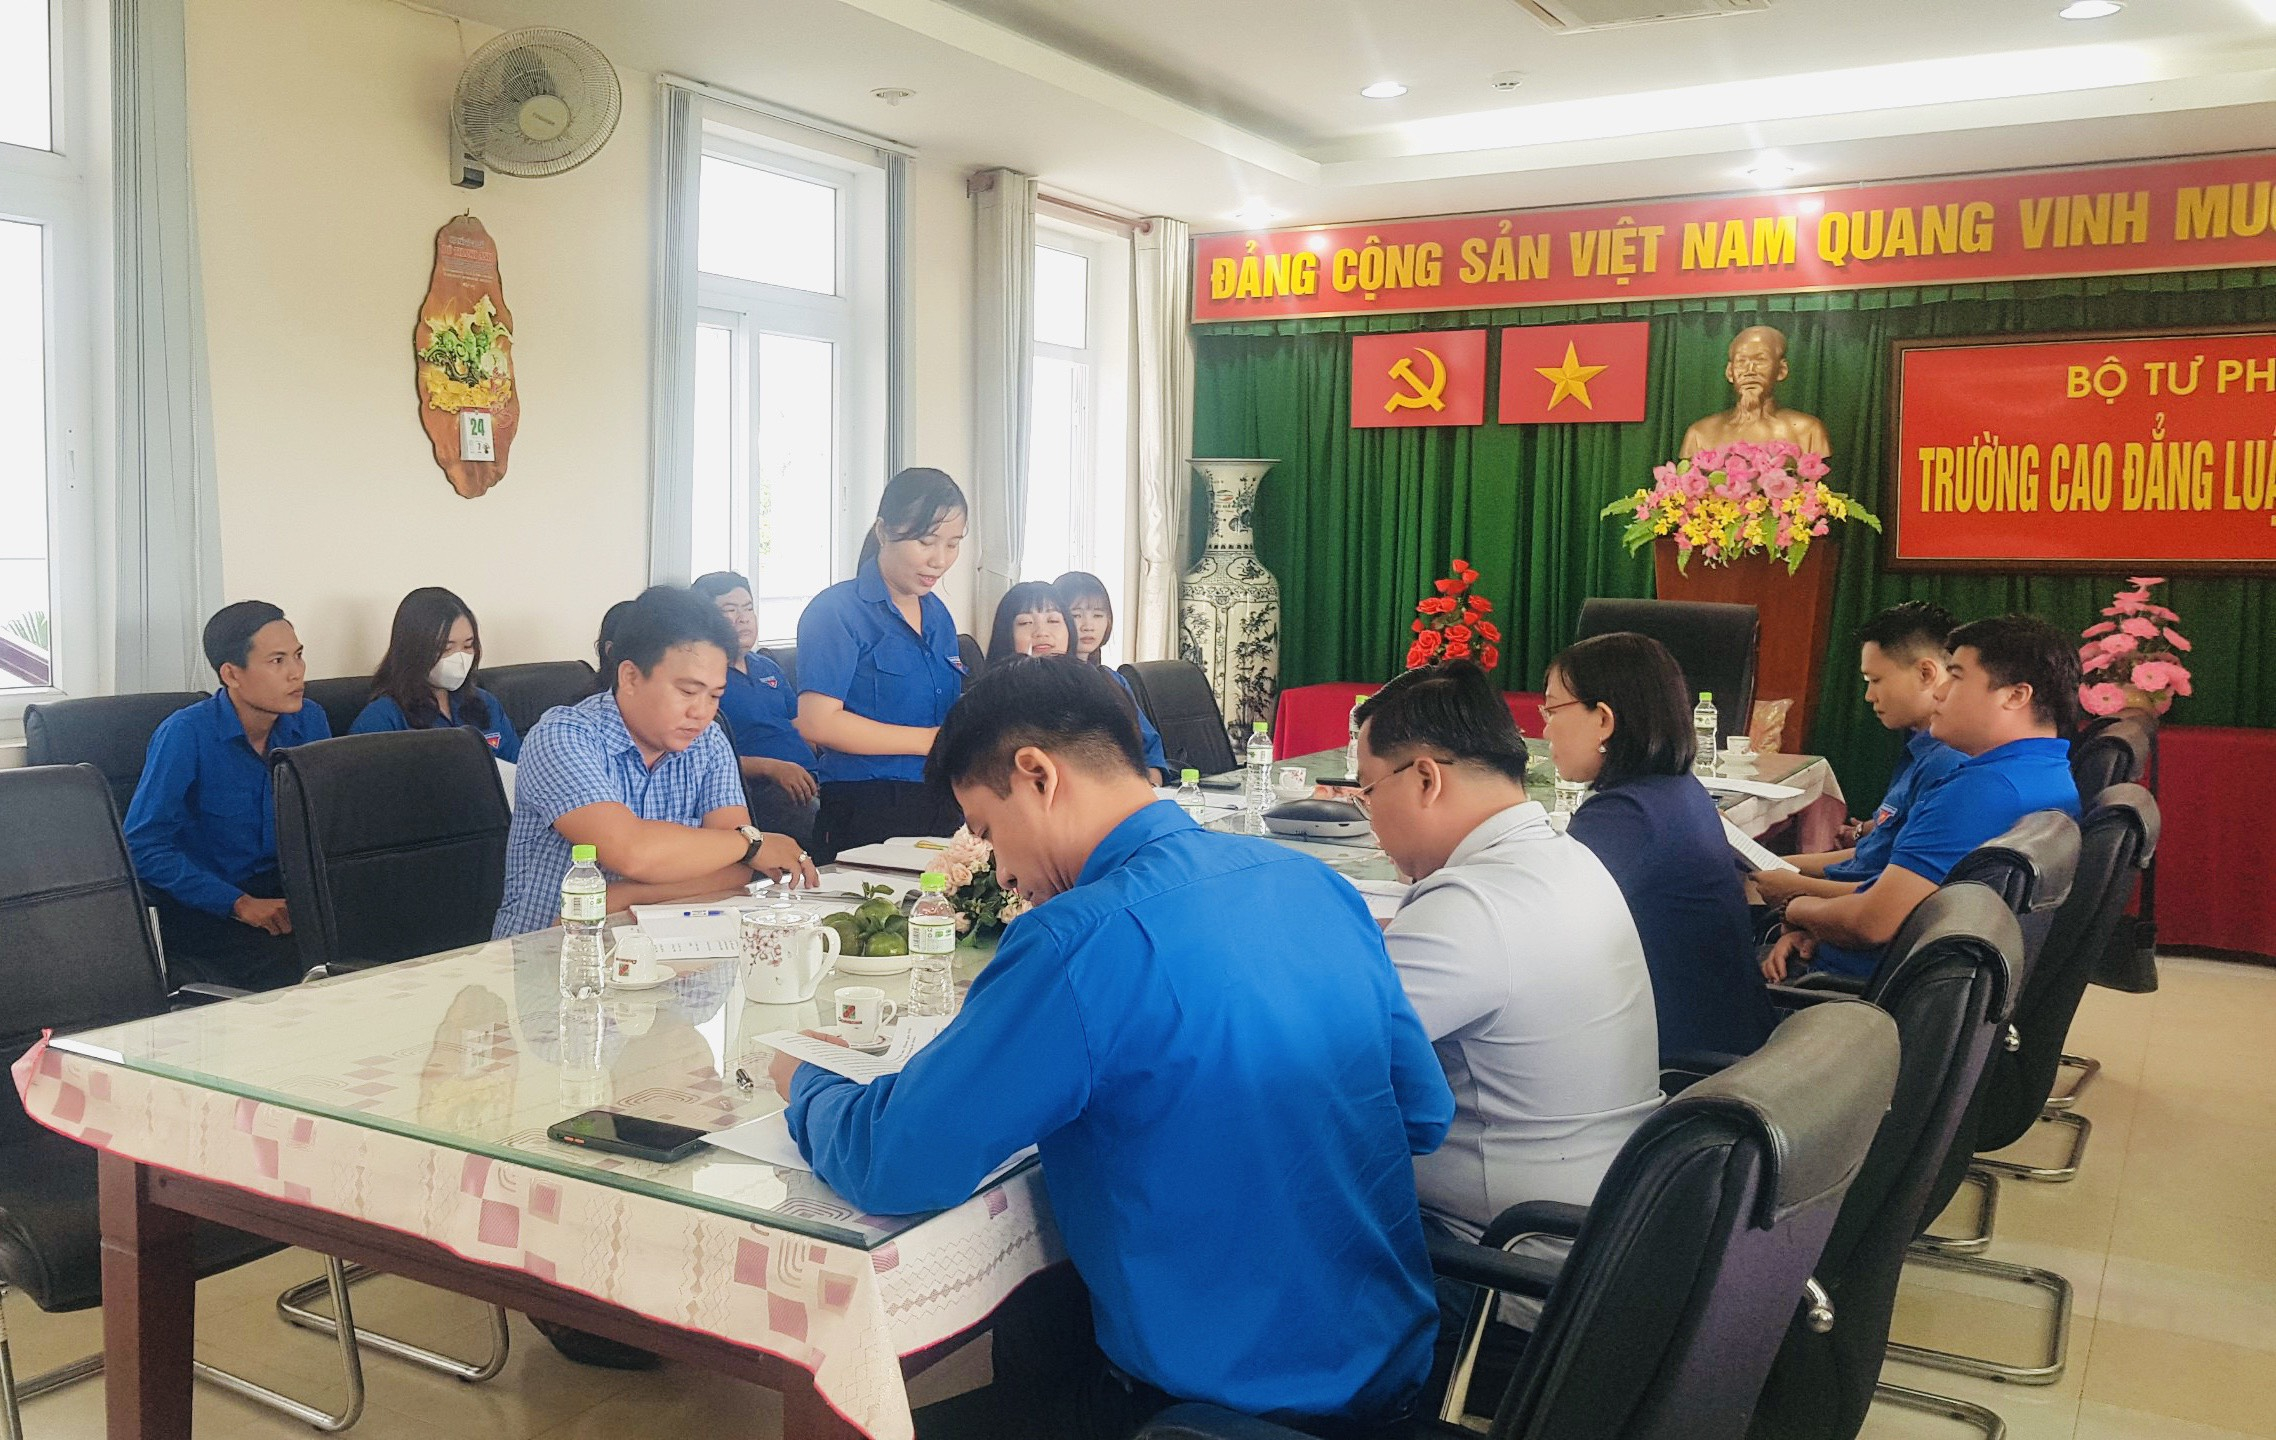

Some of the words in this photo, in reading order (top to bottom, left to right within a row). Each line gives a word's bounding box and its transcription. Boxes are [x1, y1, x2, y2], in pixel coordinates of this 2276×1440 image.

[1210, 240, 1317, 299] ĐẢNG
[1332, 235, 1443, 301] CỘNG
[1459, 219, 1551, 284] SẢN
[1569, 216, 1665, 285] VIỆT
[1682, 215, 1797, 270] NAM
[1817, 201, 1994, 267] QUANG
[2020, 190, 2149, 250] VINH
[2175, 181, 2276, 241] MU
[2067, 355, 2127, 404] BỘ
[2144, 355, 2204, 396] TƯ
[2217, 358, 2276, 394] PH
[471, 418, 485, 436] 24
[1919, 431, 2040, 512] TRƯỜNG
[2050, 442, 2113, 512] CAO
[2122, 412, 2214, 512] ĐẲNG
